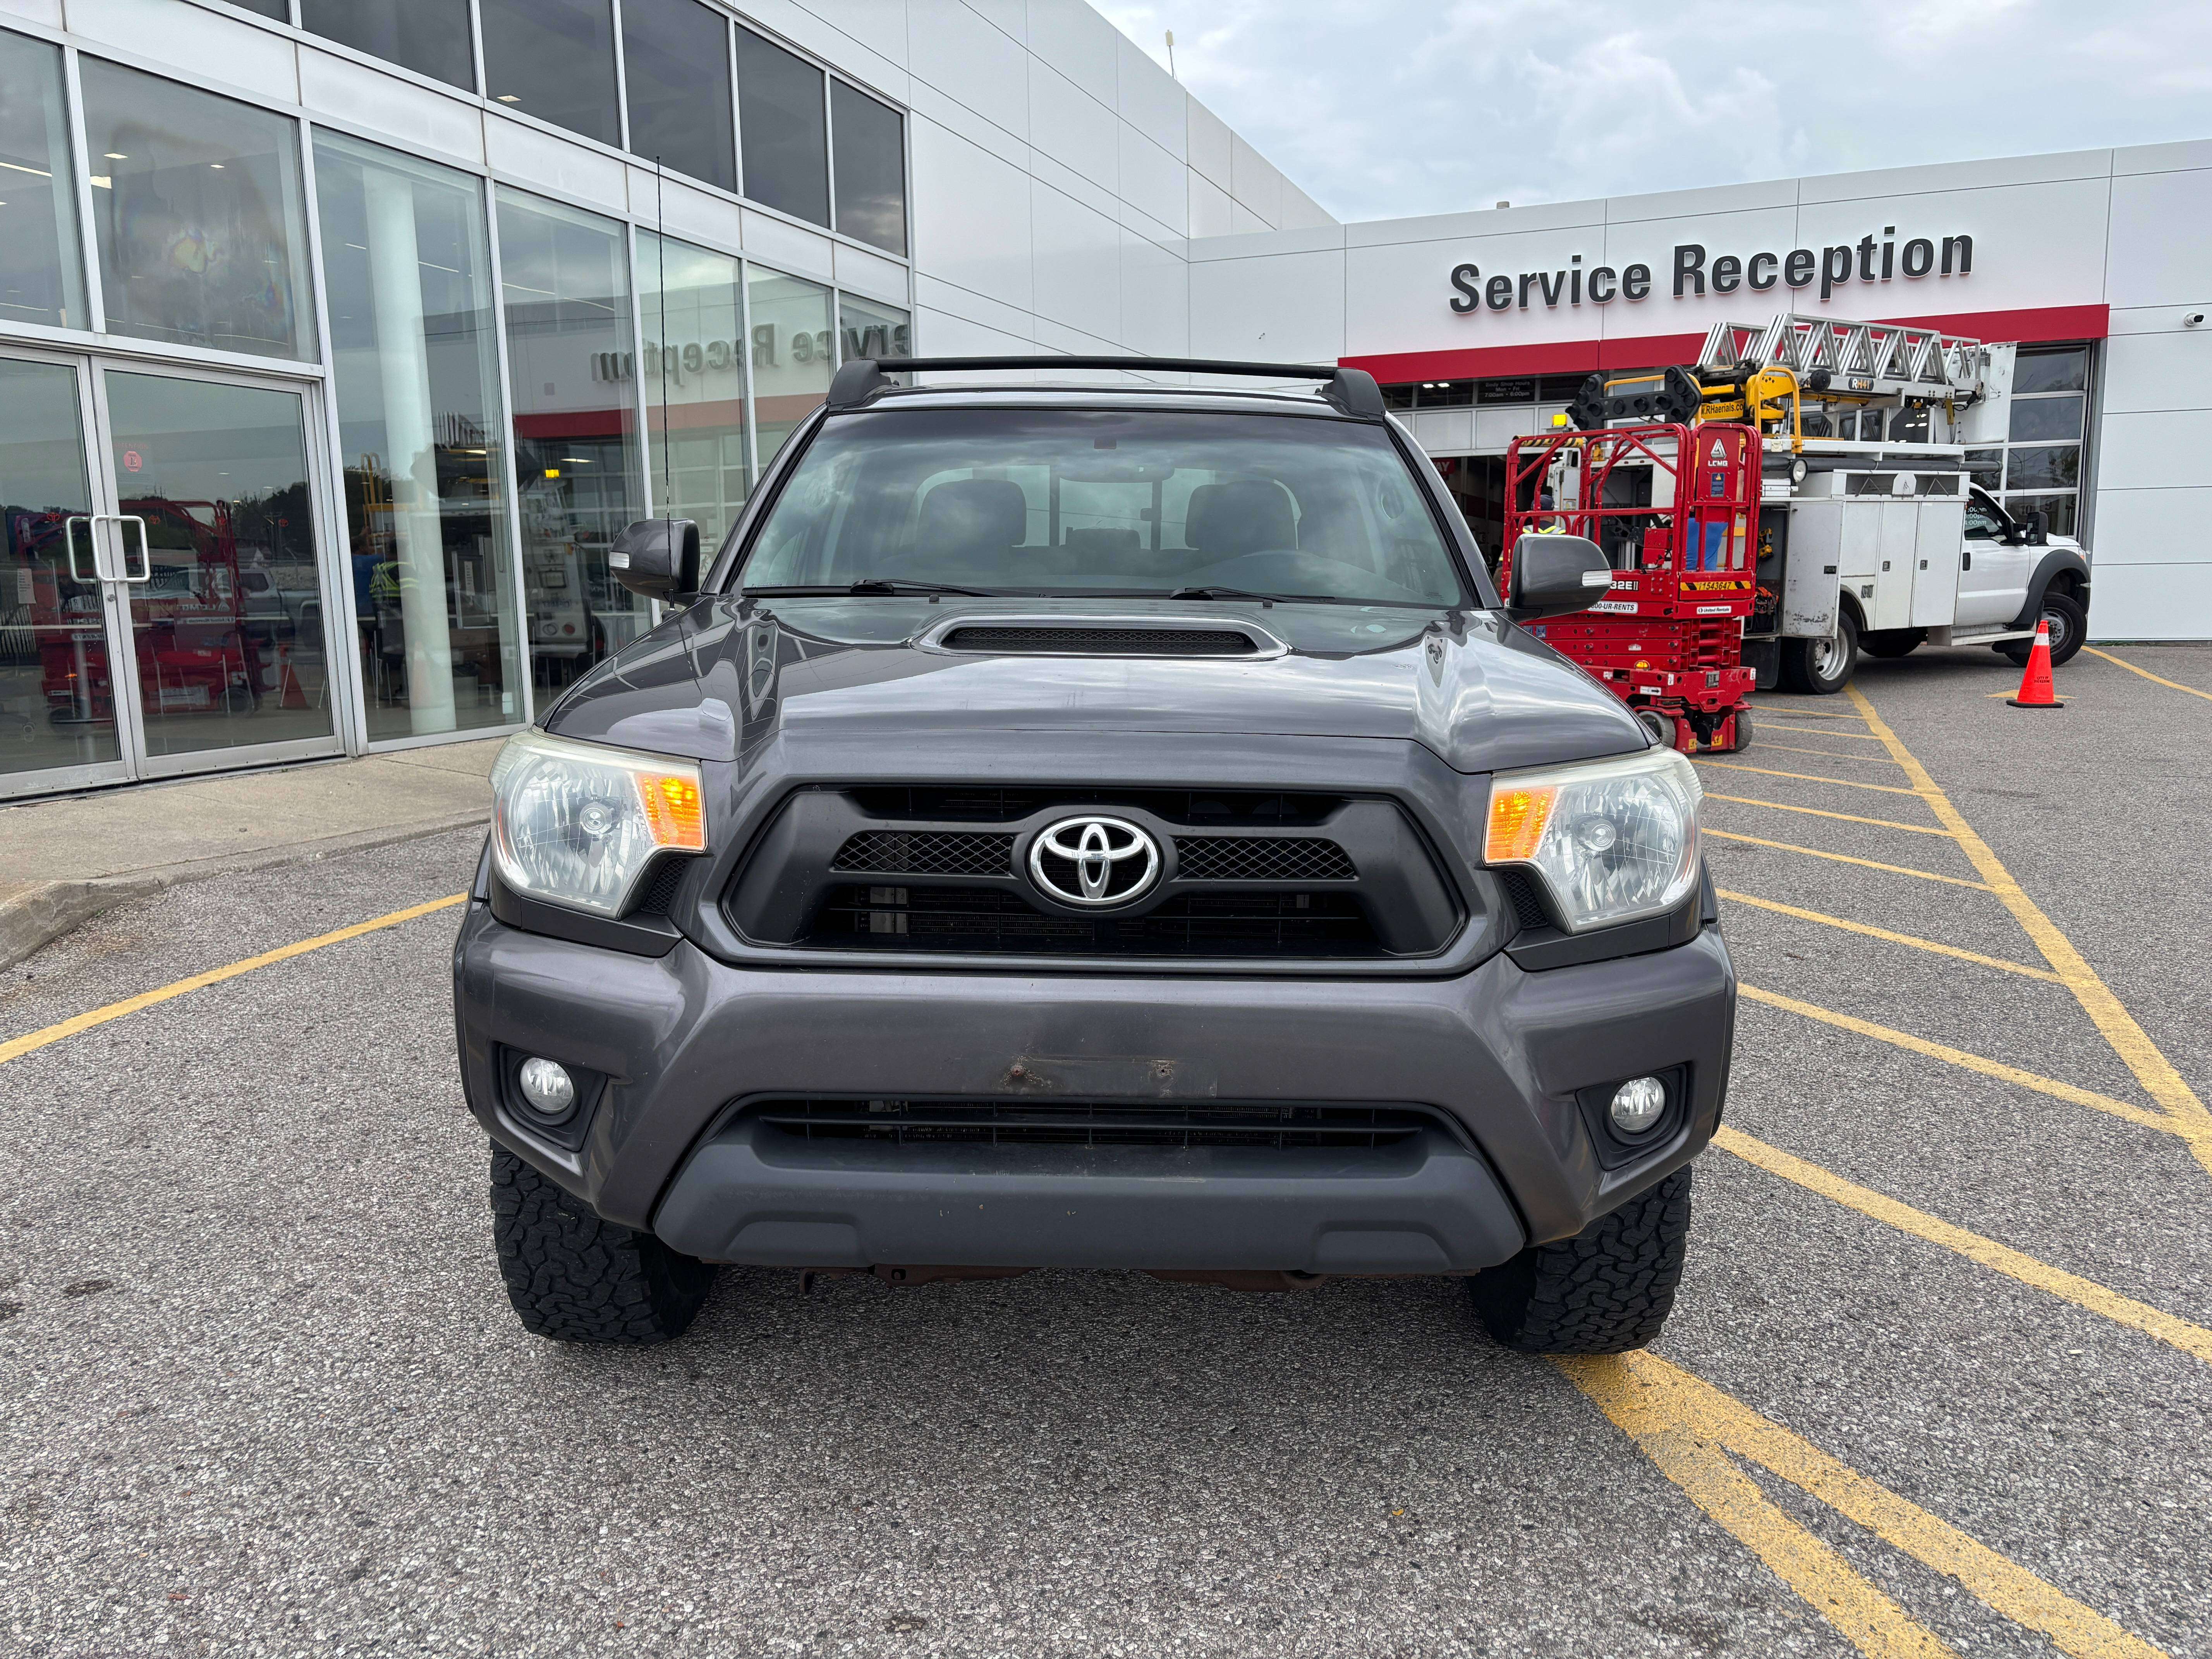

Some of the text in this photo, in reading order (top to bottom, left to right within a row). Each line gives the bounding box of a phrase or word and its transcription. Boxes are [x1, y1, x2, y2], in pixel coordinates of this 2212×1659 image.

[1449, 226, 1973, 313] Service Reception
[1852, 378, 1869, 390] RH41
[1702, 403, 1743, 415] .RHaerials.co
[1434, 462, 1450, 472] AY
